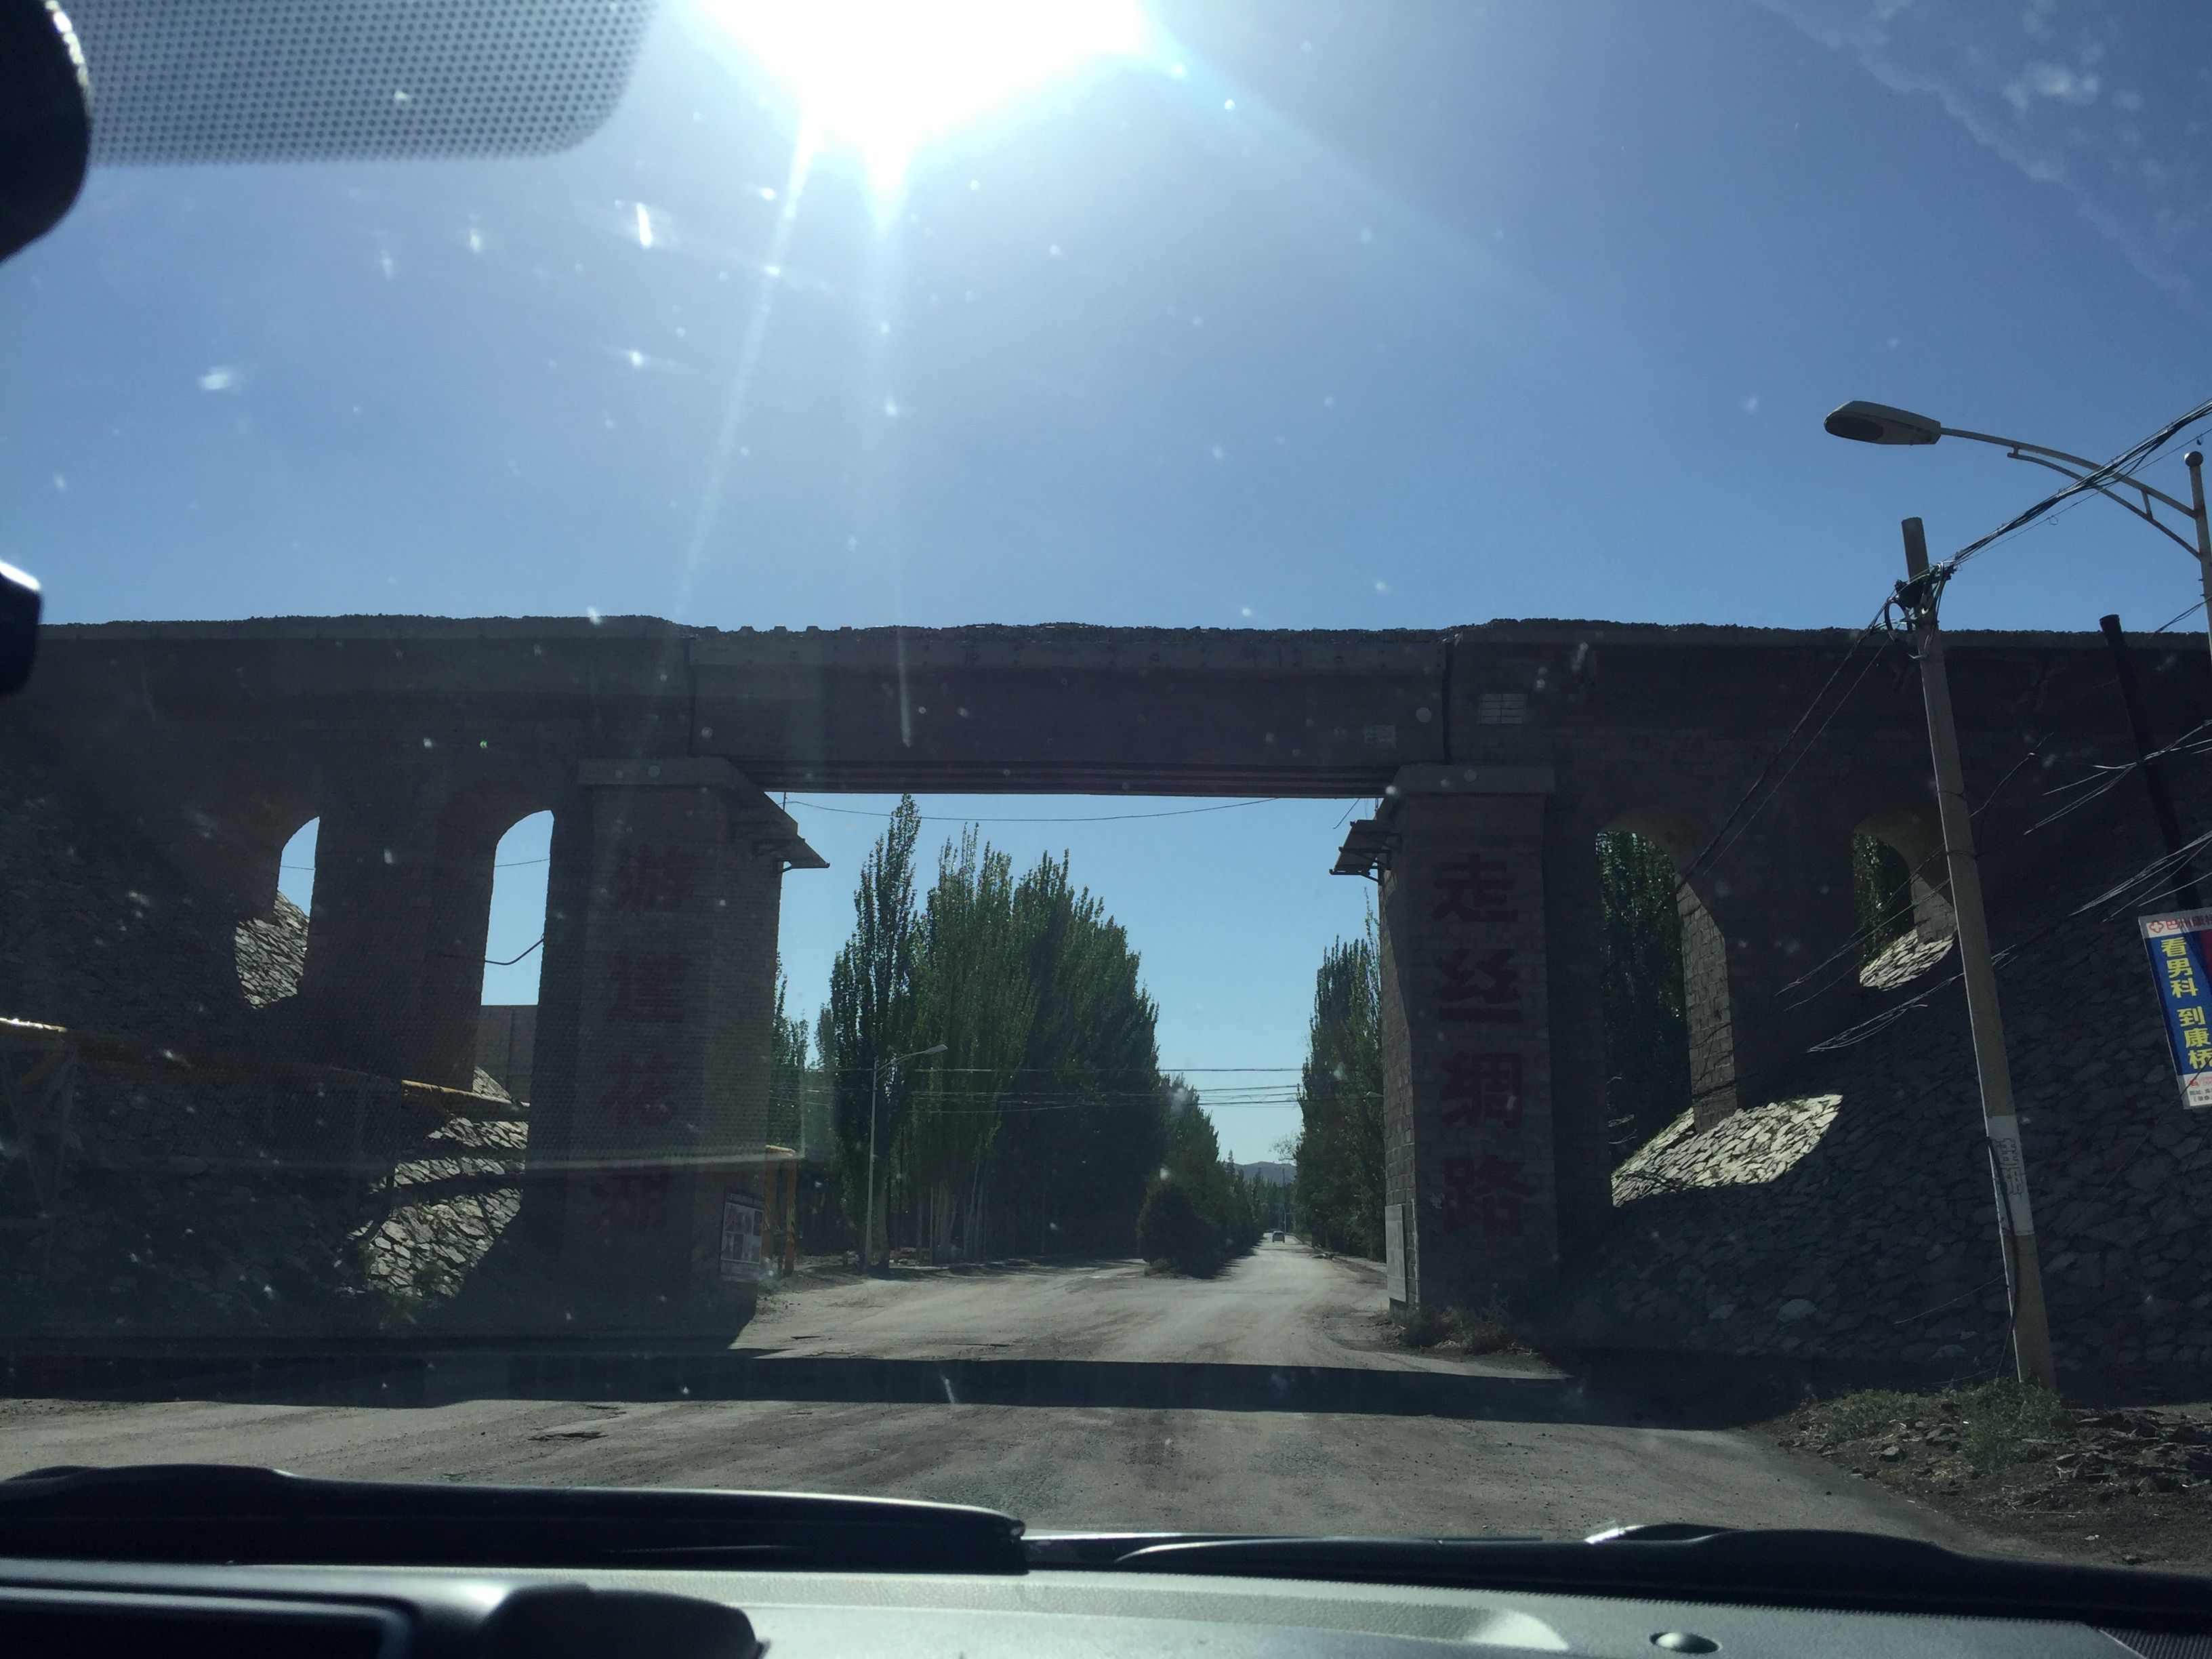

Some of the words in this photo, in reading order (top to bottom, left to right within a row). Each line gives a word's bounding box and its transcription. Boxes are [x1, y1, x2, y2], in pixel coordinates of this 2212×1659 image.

[1430, 853, 1534, 1237] 走丝绸路
[2160, 937, 2198, 998] 看男科
